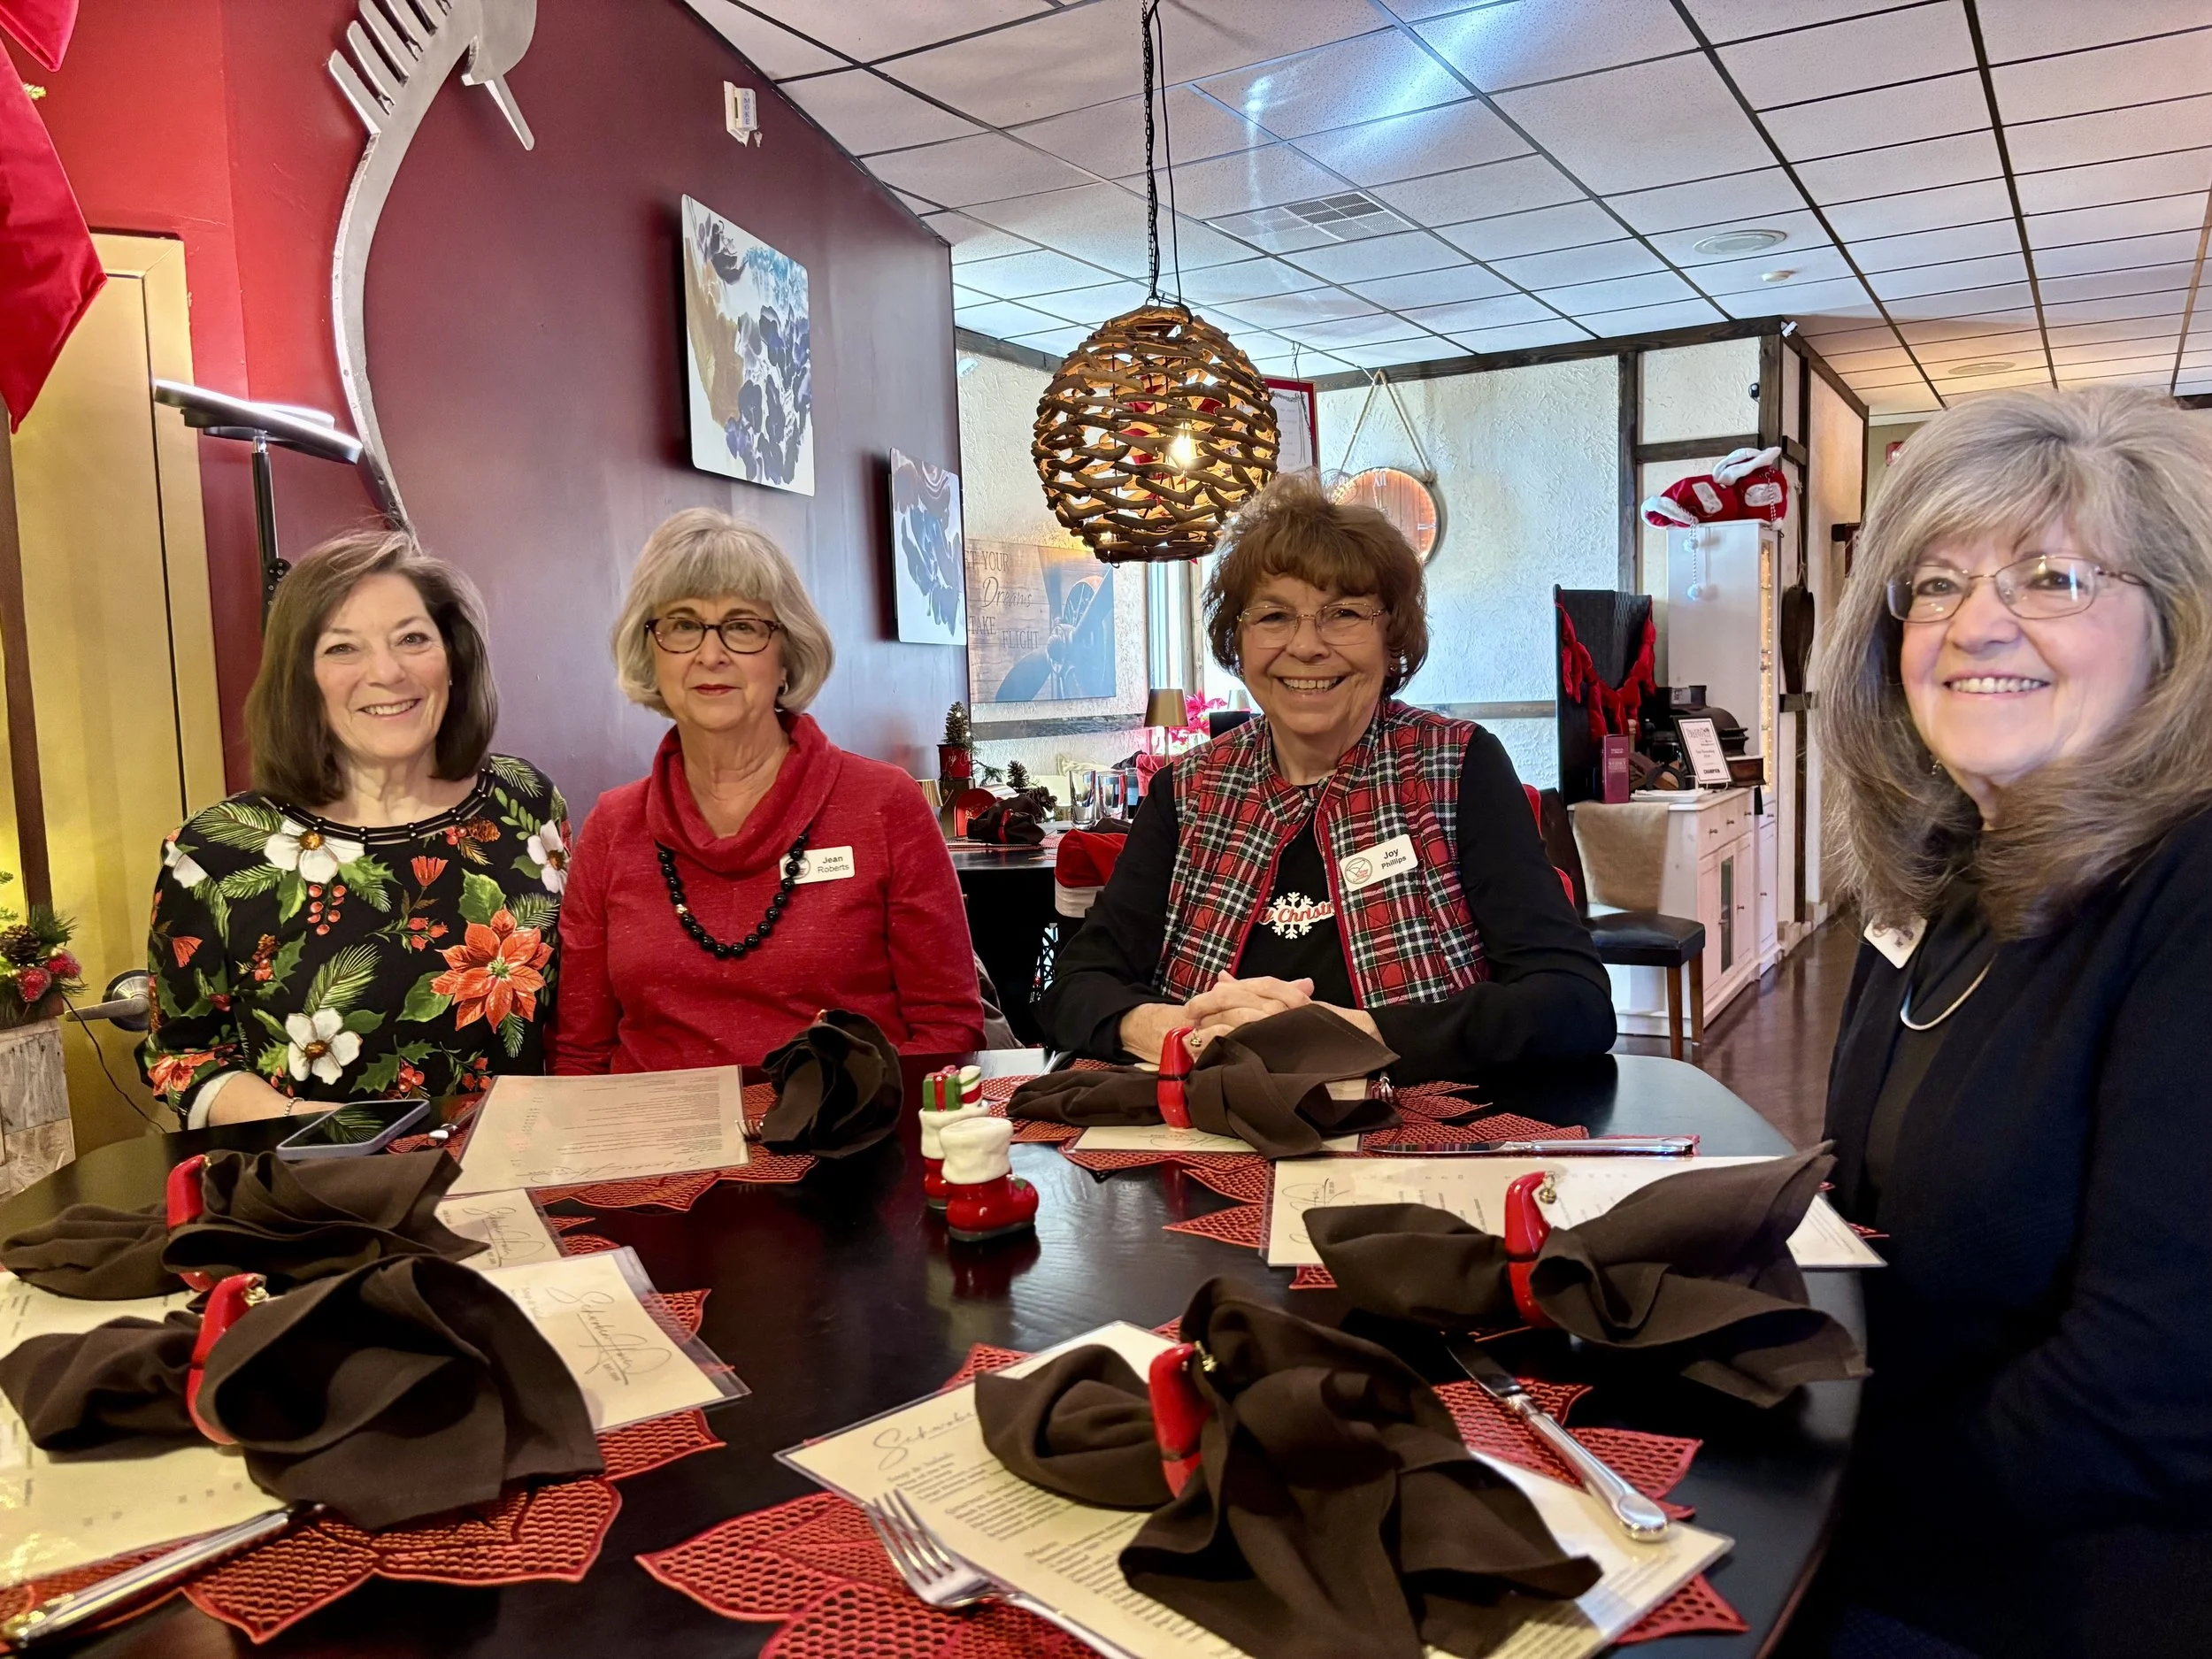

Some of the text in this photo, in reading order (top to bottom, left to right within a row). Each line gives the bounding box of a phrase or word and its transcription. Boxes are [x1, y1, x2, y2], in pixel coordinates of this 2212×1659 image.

[981, 550, 1010, 572] YOUR
[981, 576, 1033, 608] Dreams
[969, 615, 997, 635] TAKE
[1002, 630, 1040, 649] FLIGHT
[1381, 856, 1407, 870] Phillips
[1384, 849, 1399, 859] Joy
[818, 864, 849, 873] Roberts
